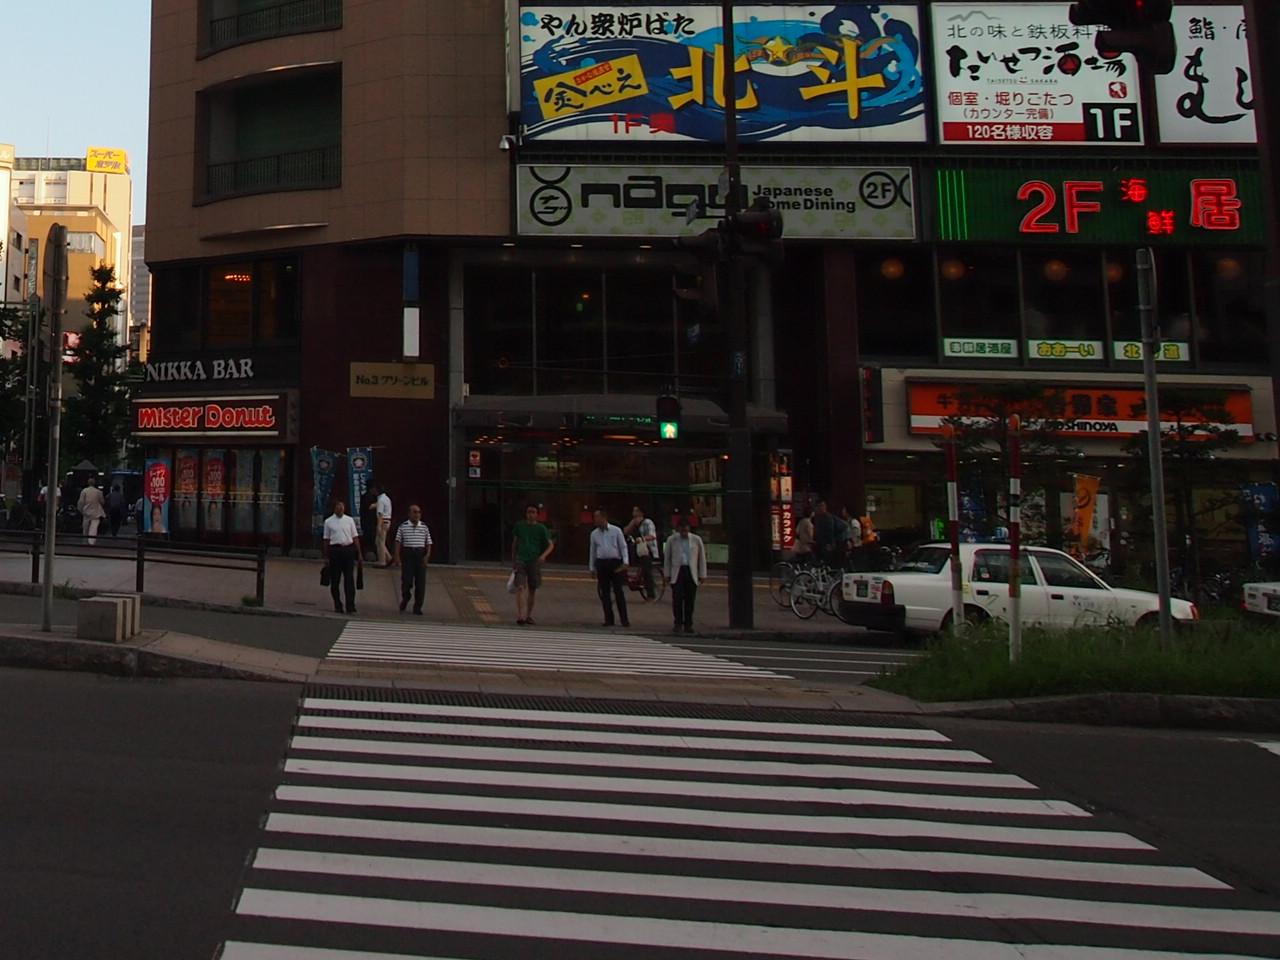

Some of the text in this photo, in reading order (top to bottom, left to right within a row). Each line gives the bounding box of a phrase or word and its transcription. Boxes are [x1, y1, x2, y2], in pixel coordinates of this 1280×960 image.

[541, 12, 696, 38] やん衆炉ばた
[667, 38, 887, 120] 北斗
[966, 124, 1054, 140] 120名様収容
[1089, 107, 1132, 139] 1F
[753, 184, 833, 199] Japanese
[865, 182, 893, 200] 2F
[754, 198, 856, 213] ome Dining
[1017, 180, 1104, 234] 2F
[1124, 343, 1181, 359] 北道
[145, 358, 254, 383] NIKKA BAR
[138, 404, 276, 429] Mister Donut
